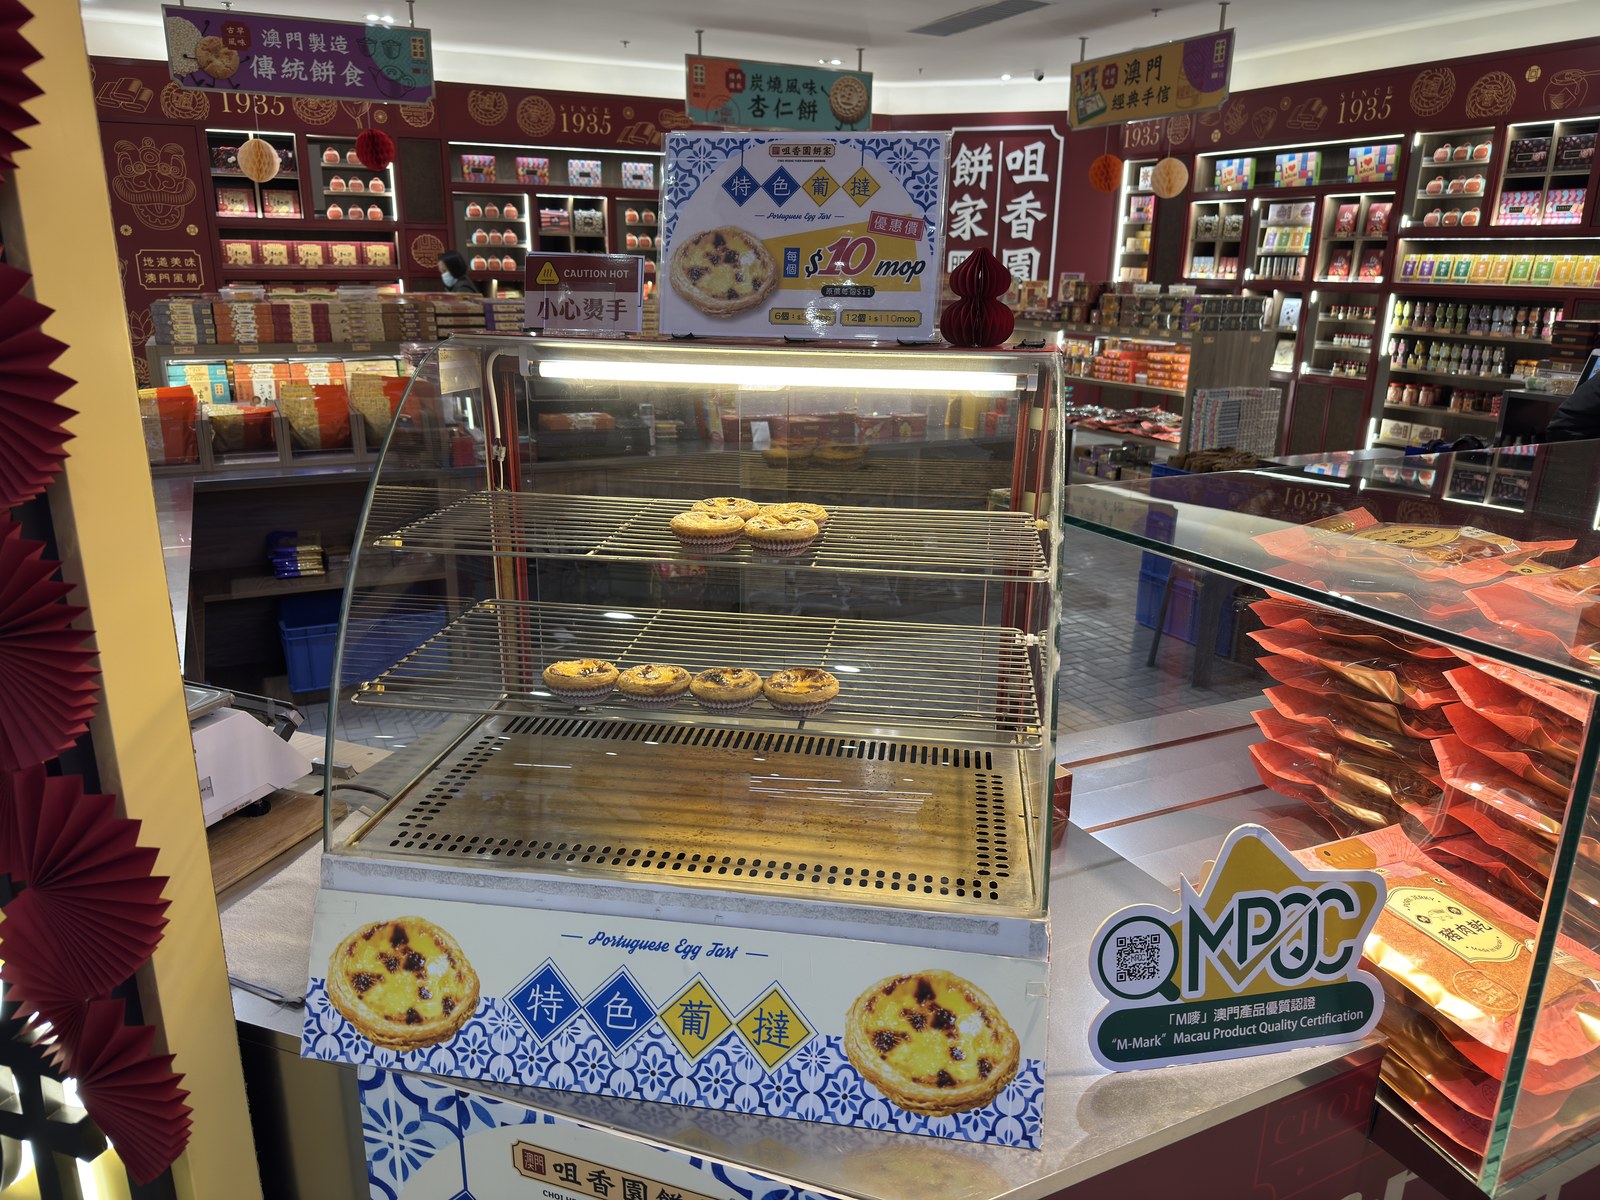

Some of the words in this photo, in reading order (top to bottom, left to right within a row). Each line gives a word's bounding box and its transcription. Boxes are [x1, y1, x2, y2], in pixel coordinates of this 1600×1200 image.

[226, 26, 245, 35] 古早
[261, 28, 349, 54] 澳門製造
[249, 54, 365, 88] 傳統餅食
[1123, 54, 1163, 86] 澳門
[749, 73, 818, 96] 炭燒風味
[1341, 86, 1393, 100] SINCE
[222, 92, 285, 116] 1935
[560, 105, 610, 114] SINCE
[748, 94, 818, 122] 杏仁餅
[1111, 85, 1171, 111] 經典手信
[1338, 95, 1393, 124] 1935
[560, 112, 611, 135] 1935
[1124, 126, 1161, 148] 1935
[731, 176, 871, 197] 特色葡撻
[949, 142, 994, 241] 餅家
[766, 212, 802, 222] Portuguese
[804, 213, 817, 222] Egg
[818, 213, 832, 221] Tart
[1001, 141, 1050, 285] 咀香園
[874, 216, 919, 236] 優惠價
[143, 257, 196, 267] 地道美味
[786, 250, 798, 275] 每個
[804, 236, 877, 278] $10
[873, 260, 926, 283] mop
[145, 273, 198, 284] 澳門風情
[564, 269, 607, 278] CAUTION
[609, 269, 630, 278] HOT
[537, 297, 628, 321] 小心燙手
[1438, 919, 1494, 942] 豬肉乾
[588, 931, 669, 954] Portuguese
[674, 938, 702, 961] Egg
[705, 942, 739, 959] Tart
[526, 983, 792, 1050] 特色葡撻
[1173, 1031, 1211, 1045] Macau
[1213, 1025, 1257, 1040] Product
[1258, 1019, 1298, 1036] Quality
[1300, 1010, 1364, 1028] Certification
[523, 1150, 546, 1175] 澳門
